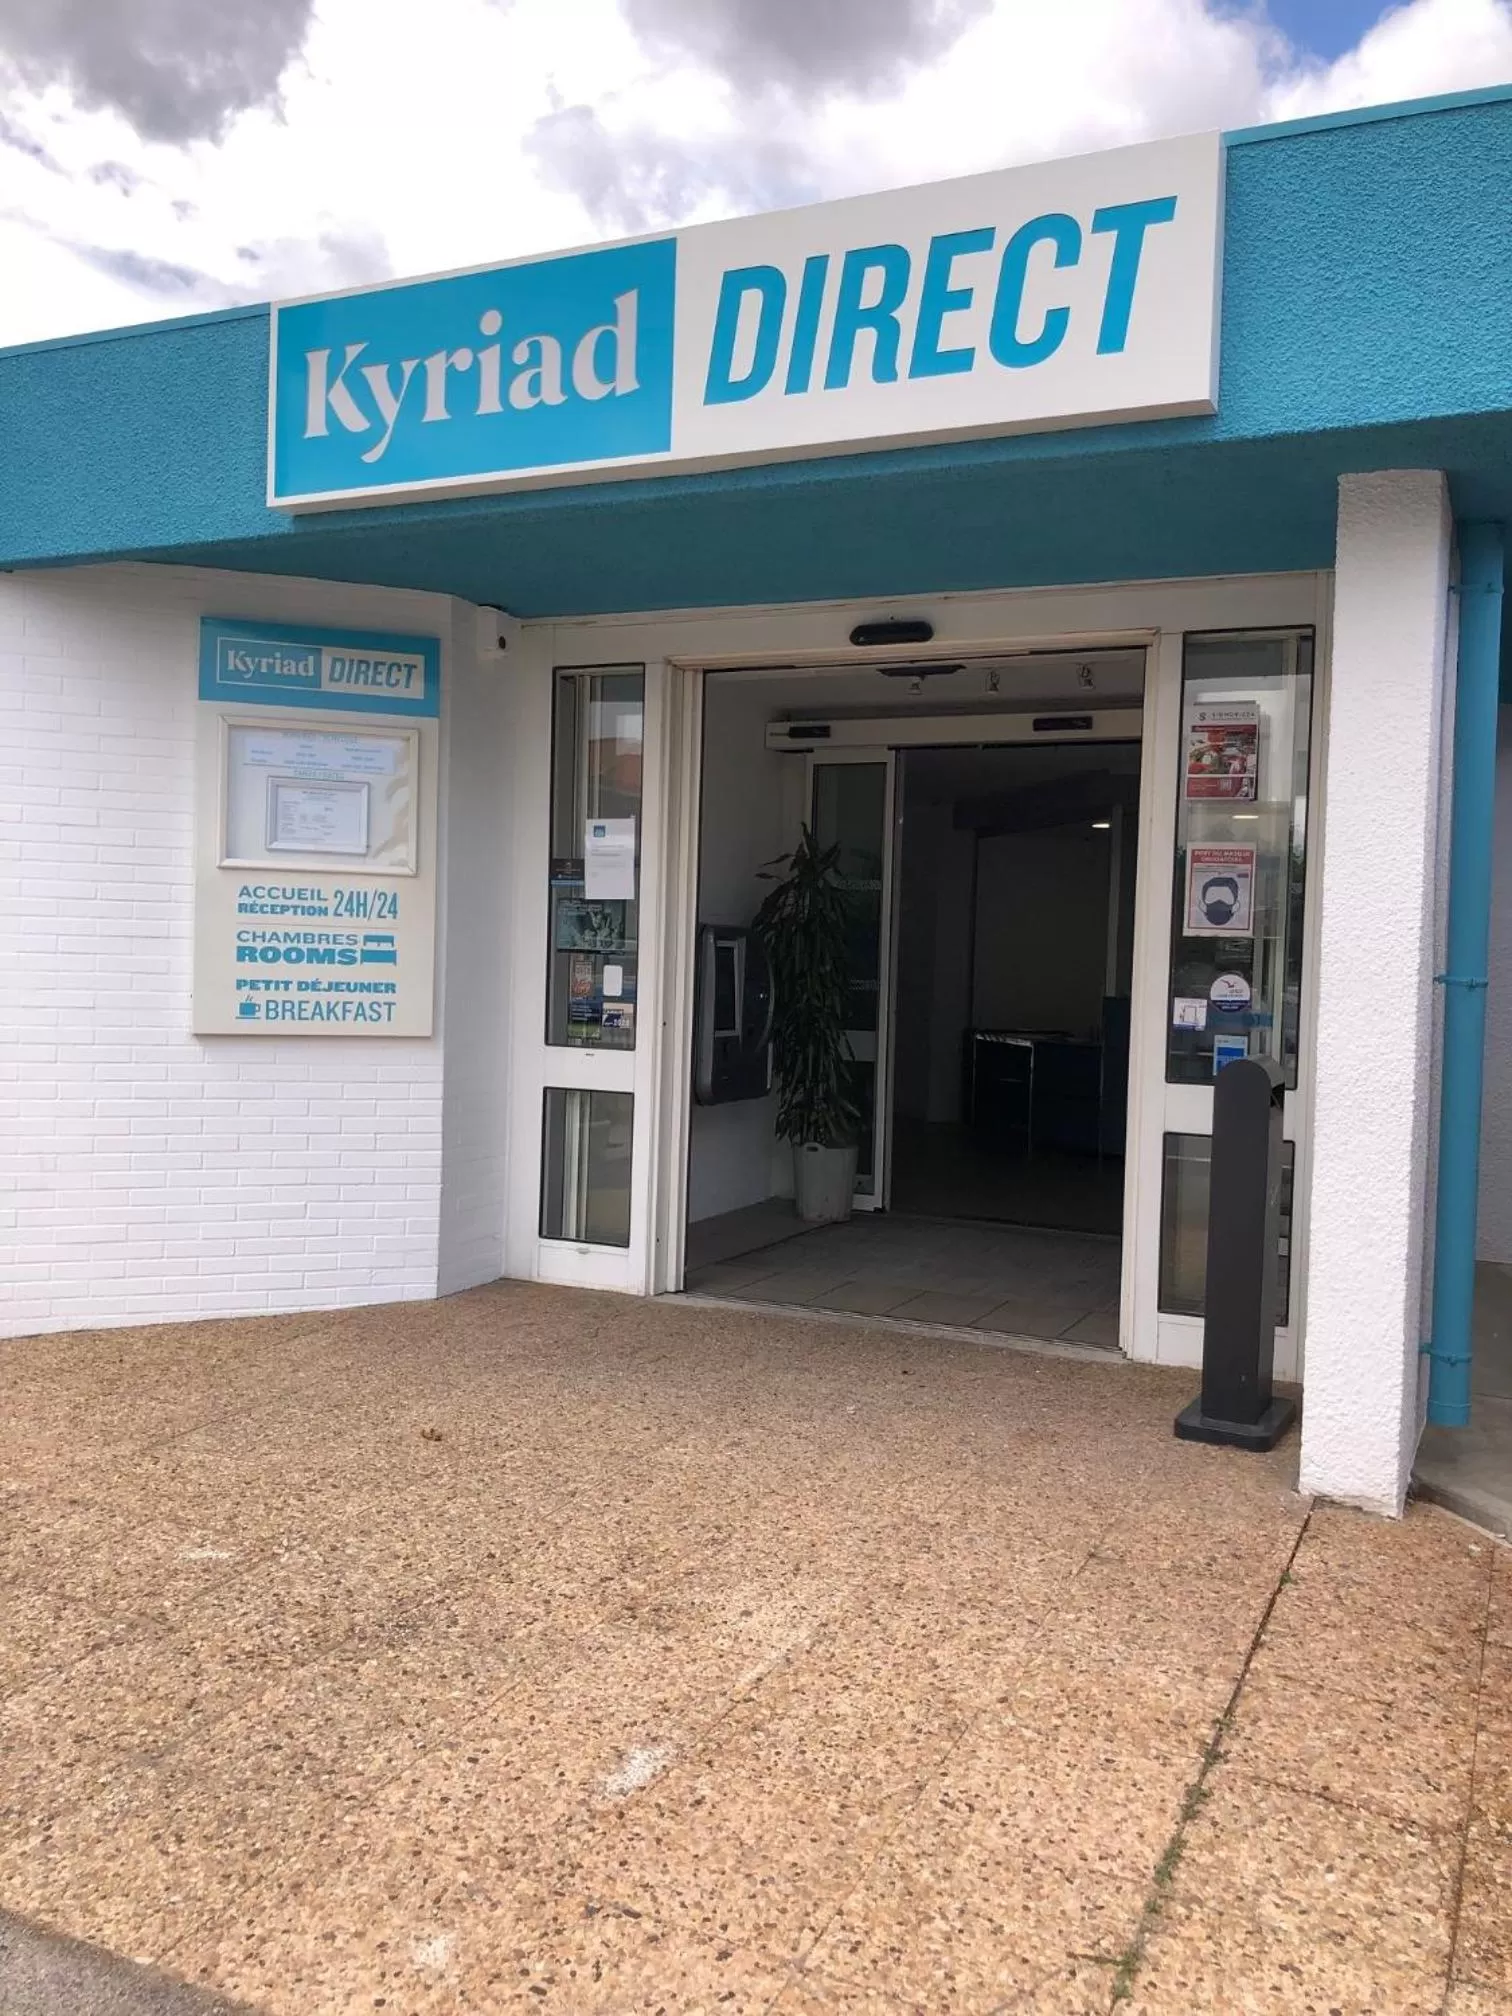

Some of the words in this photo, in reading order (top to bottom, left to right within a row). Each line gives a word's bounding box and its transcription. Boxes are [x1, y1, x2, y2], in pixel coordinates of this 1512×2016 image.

[302, 287, 640, 464] Kyriad
[703, 195, 1179, 406] DIRECT
[227, 650, 315, 679] Kyriad
[328, 656, 418, 689] DIRECT
[237, 900, 329, 917] RÉCEPTION
[238, 885, 329, 902] ACCUEIL
[333, 888, 398, 920] 24H/24
[236, 930, 359, 946] CHAMBRES
[236, 945, 358, 966] ROOMS
[235, 978, 293, 991] PETIT
[297, 978, 397, 994] DÉJEUNER
[265, 999, 397, 1022] BREAKFAST
